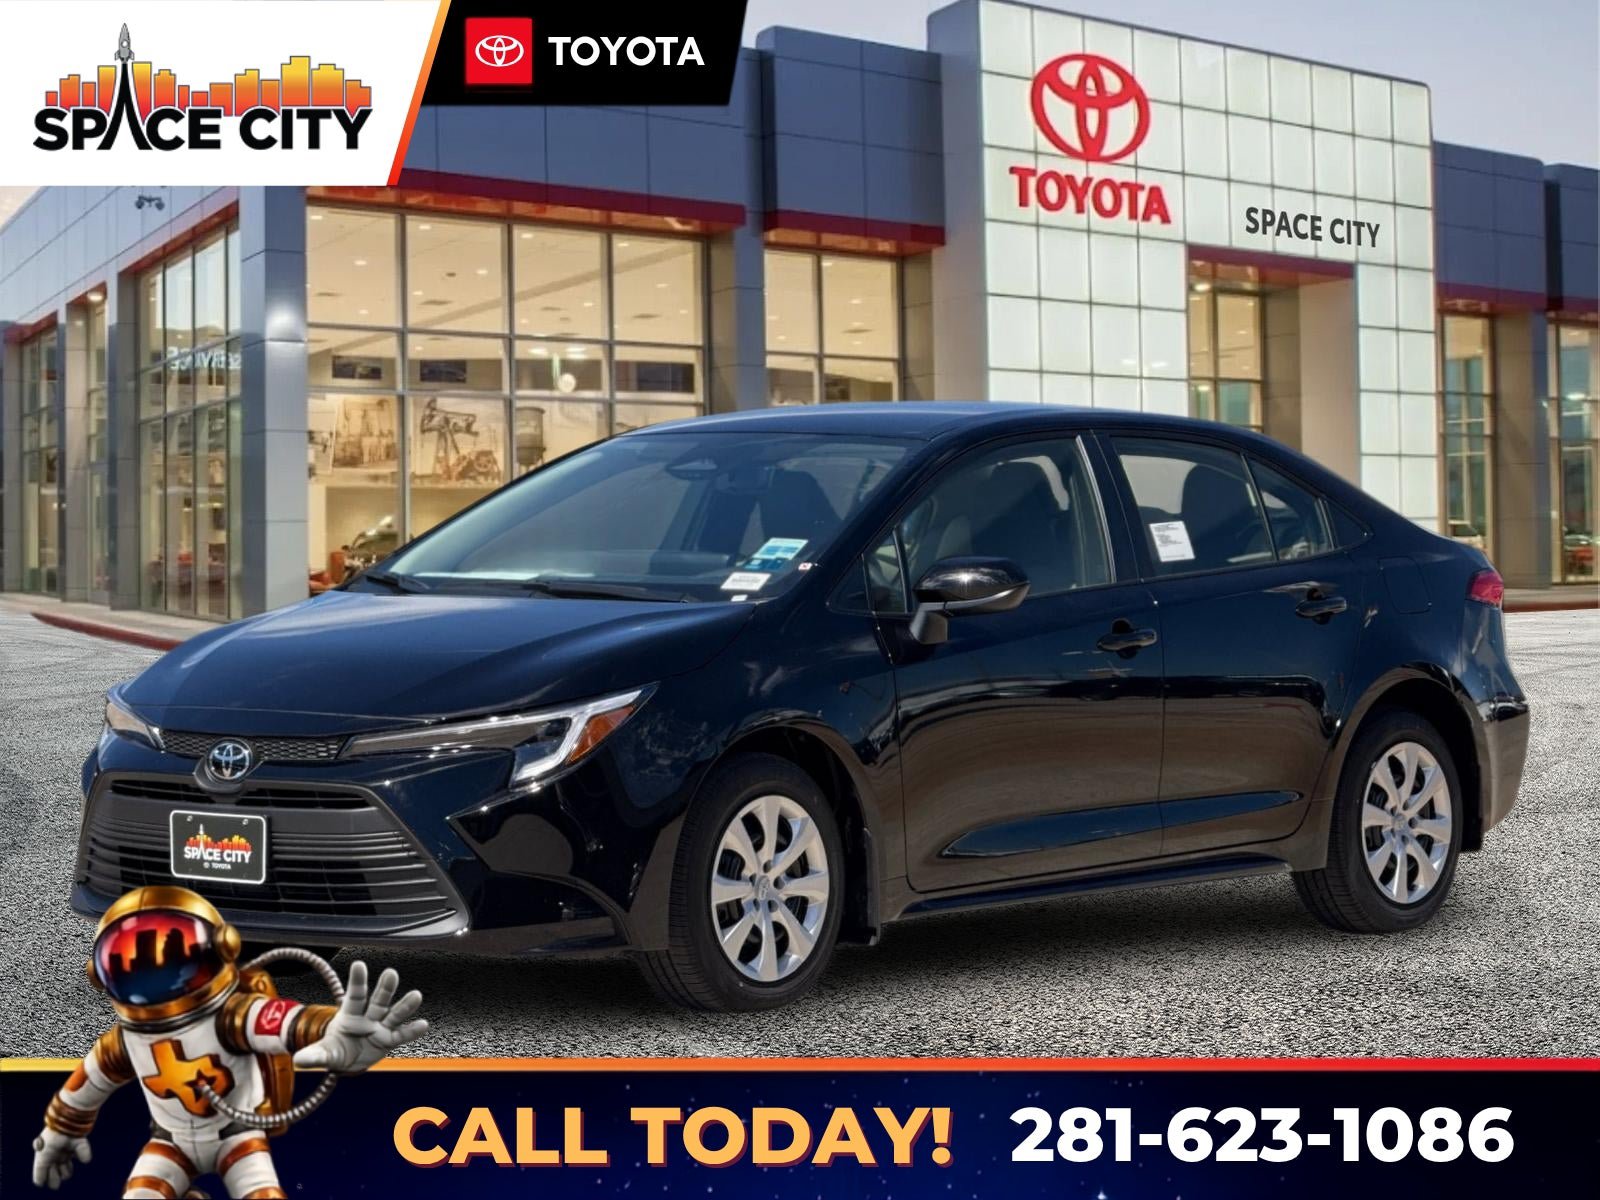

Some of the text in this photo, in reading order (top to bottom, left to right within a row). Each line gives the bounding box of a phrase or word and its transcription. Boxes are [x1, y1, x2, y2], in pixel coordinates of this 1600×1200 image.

[1009, 166, 1171, 224] TOYOTA
[1245, 206, 1380, 248] SPACE CITY
[183, 845, 252, 863] SPACE CITY
[211, 862, 232, 870] TOYOTA
